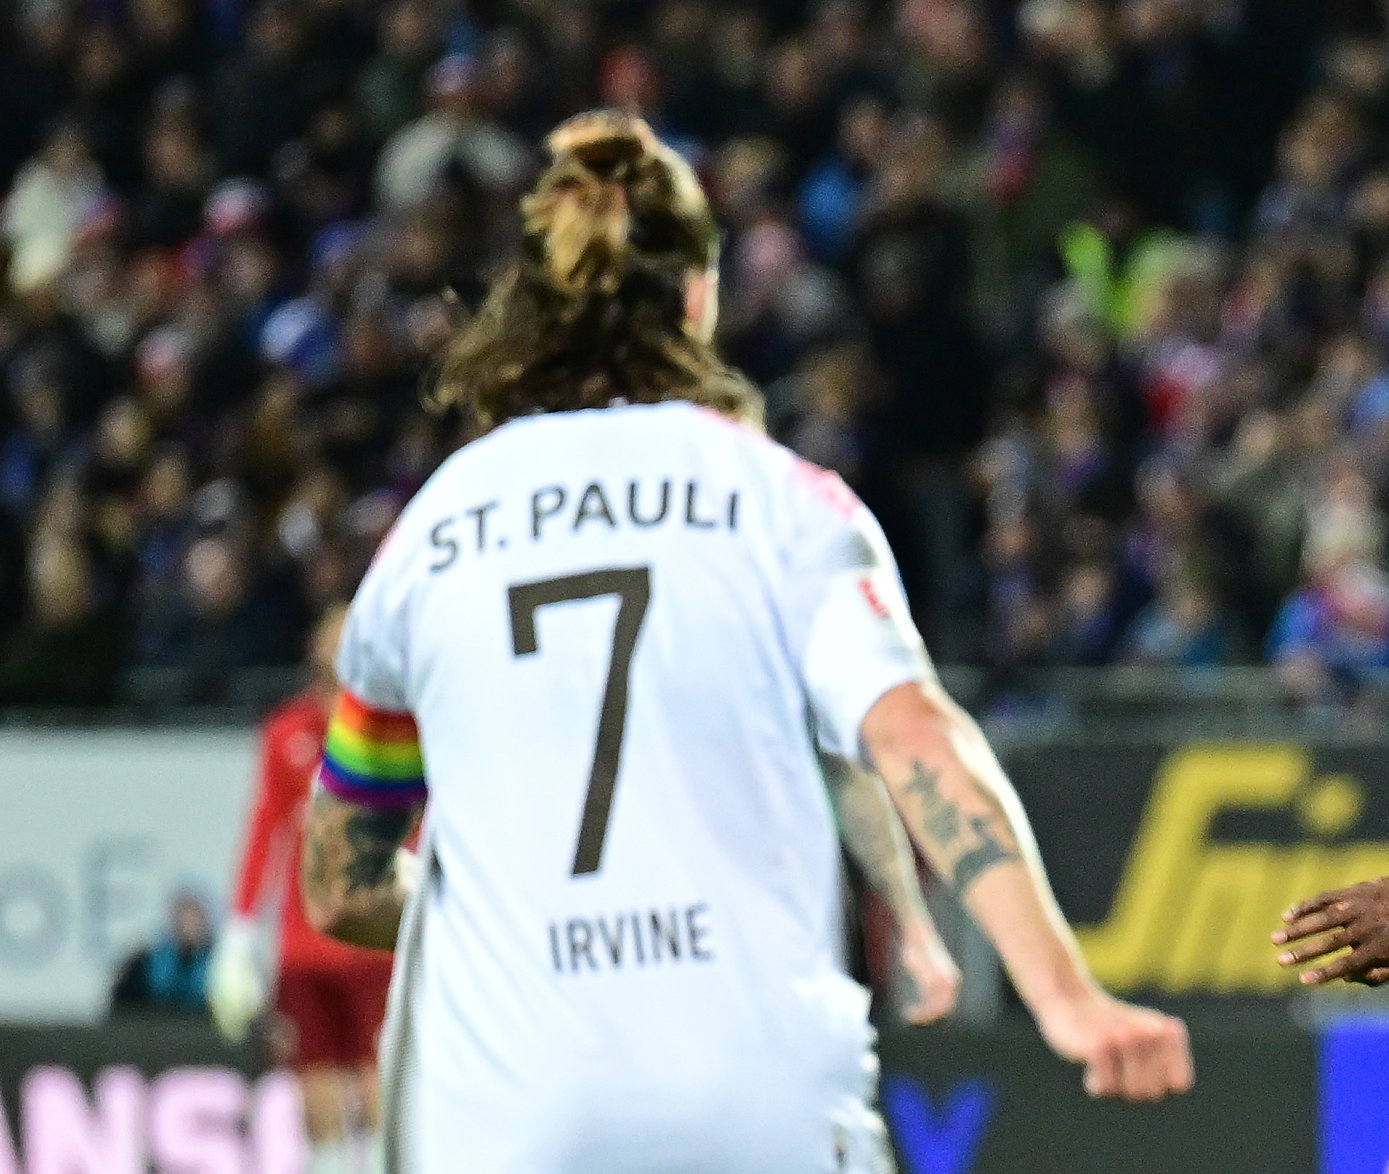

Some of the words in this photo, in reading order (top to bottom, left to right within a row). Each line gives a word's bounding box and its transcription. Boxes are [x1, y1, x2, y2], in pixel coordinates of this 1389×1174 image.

[430, 501, 506, 572] ST.
[529, 478, 739, 540] PAULI
[507, 564, 653, 877] 7
[547, 902, 717, 972] IRVINE
